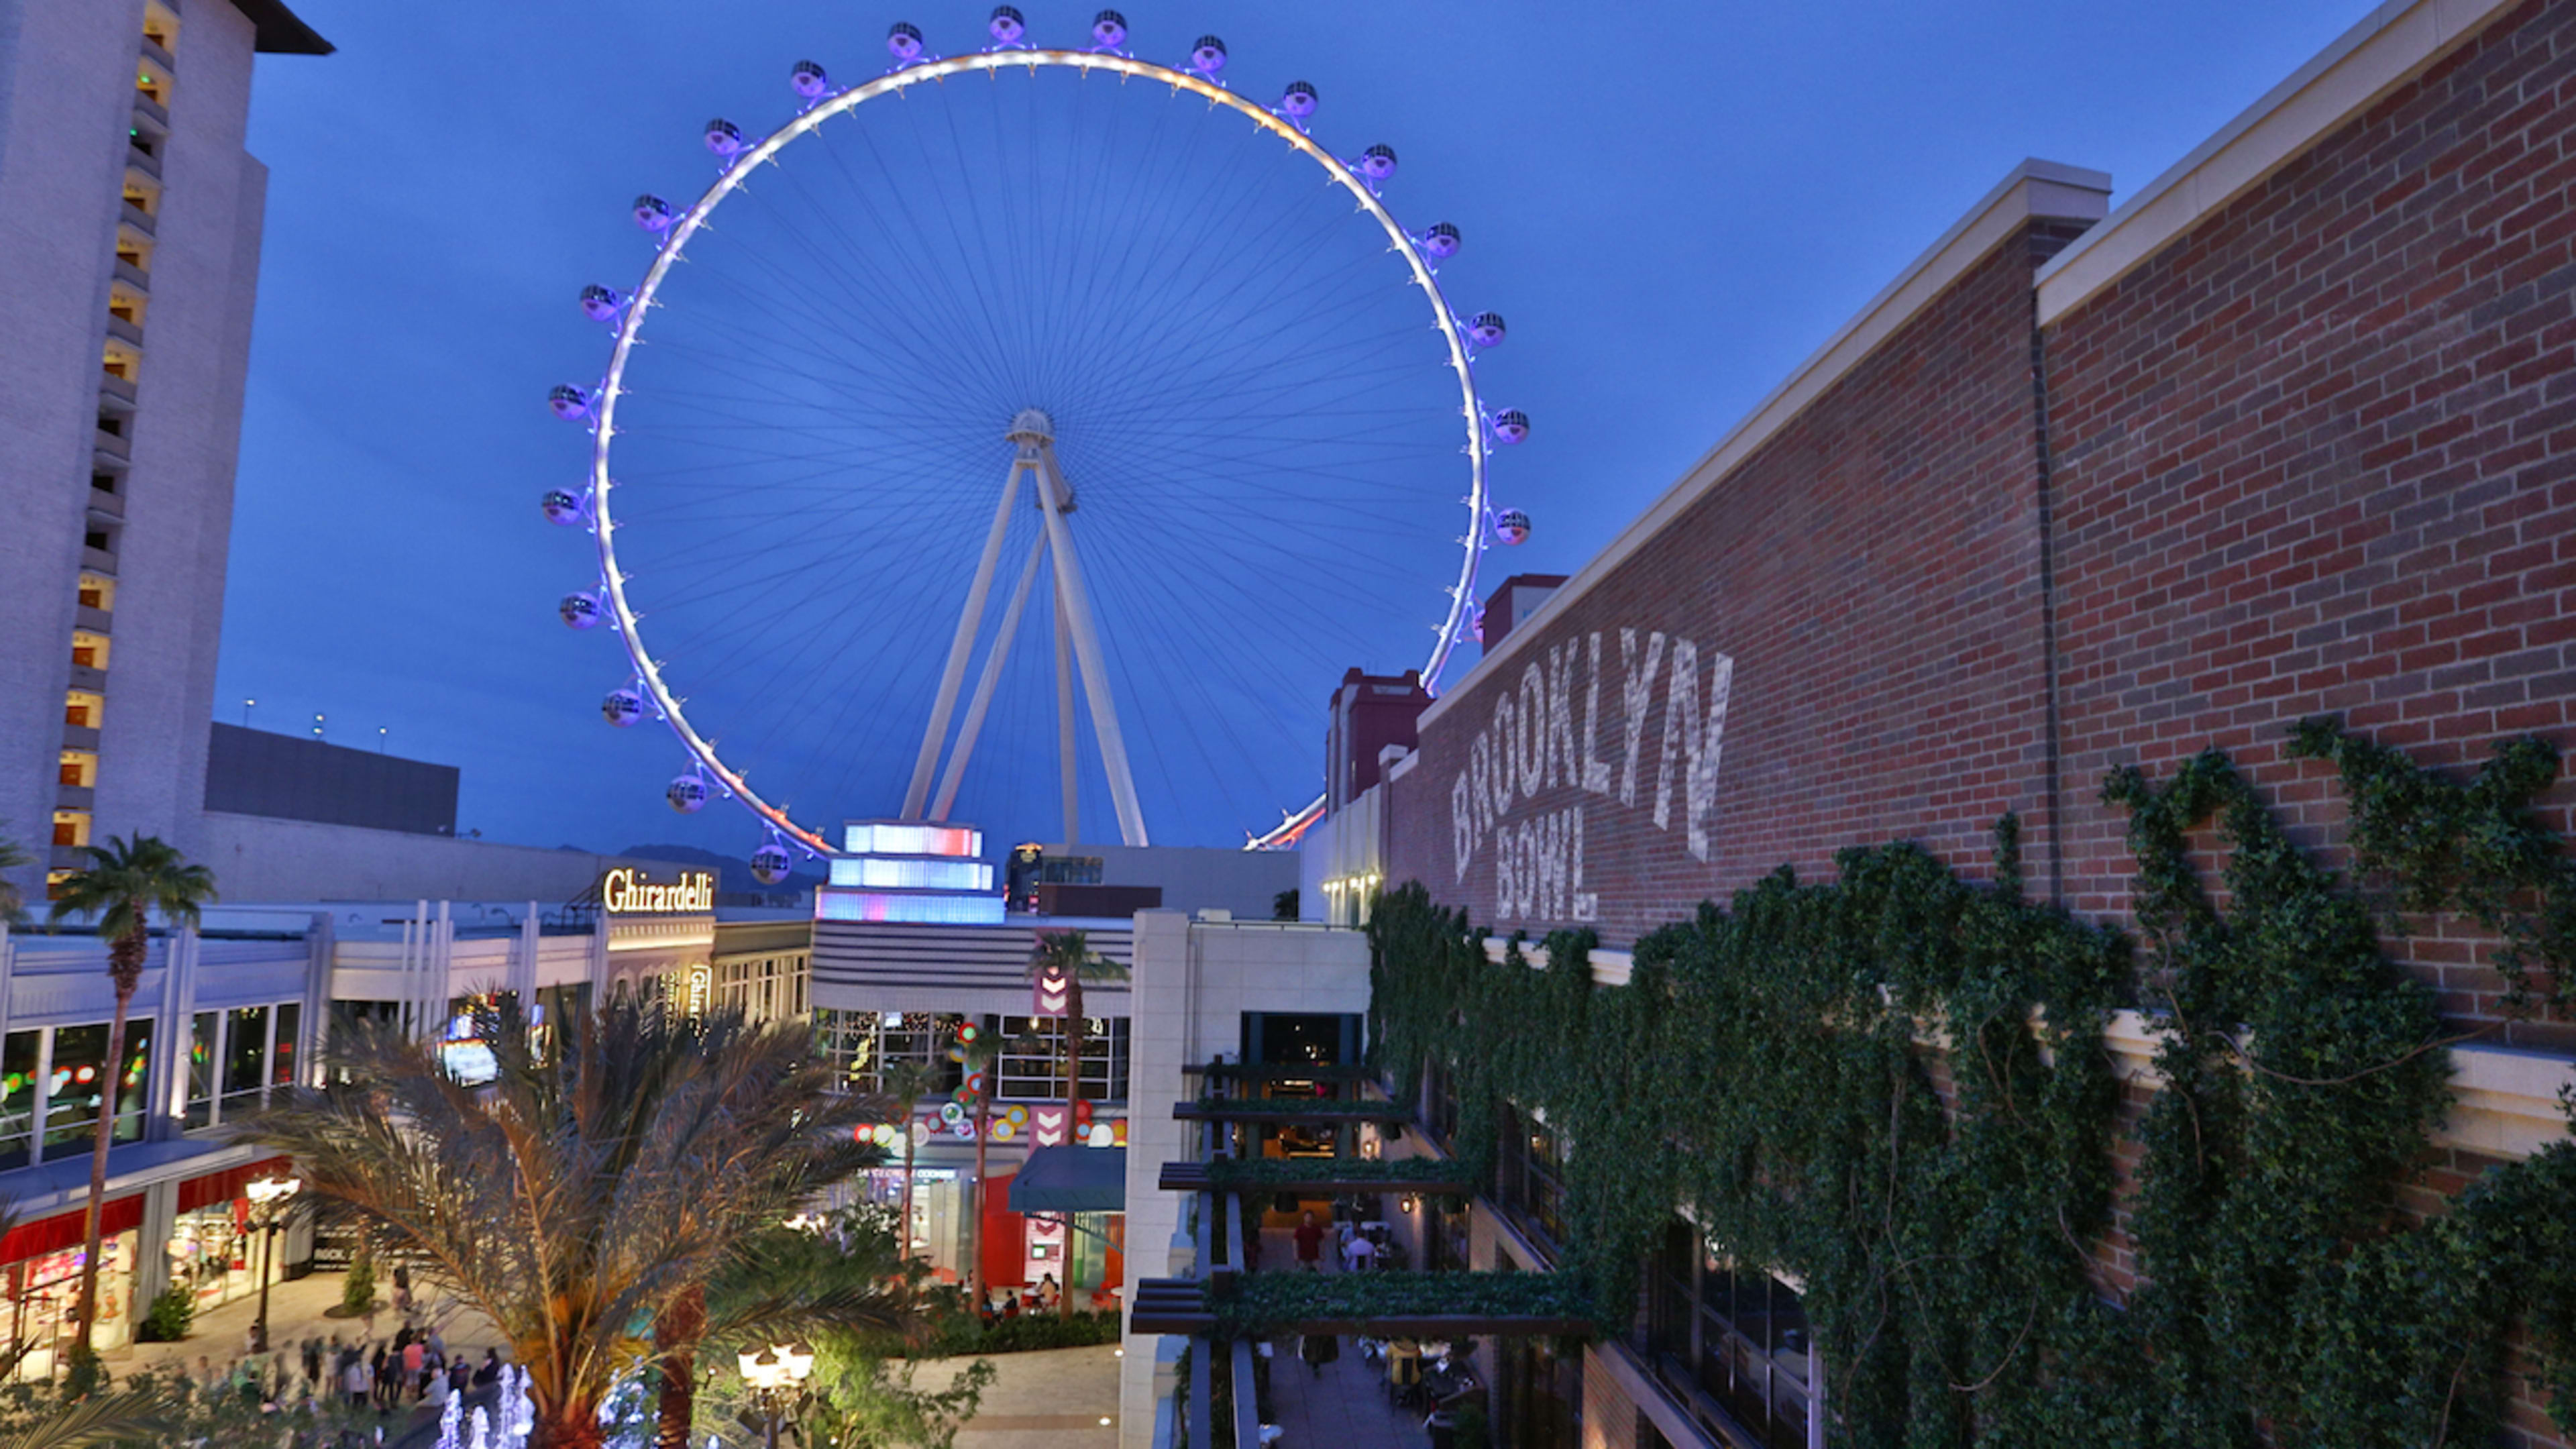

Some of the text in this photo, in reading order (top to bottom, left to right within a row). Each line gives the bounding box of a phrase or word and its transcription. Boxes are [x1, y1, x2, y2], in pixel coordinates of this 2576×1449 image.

[1452, 627, 1734, 885] BROOKLYN
[604, 868, 714, 912] Ghirardelli
[1496, 806, 1598, 922] BOWL
